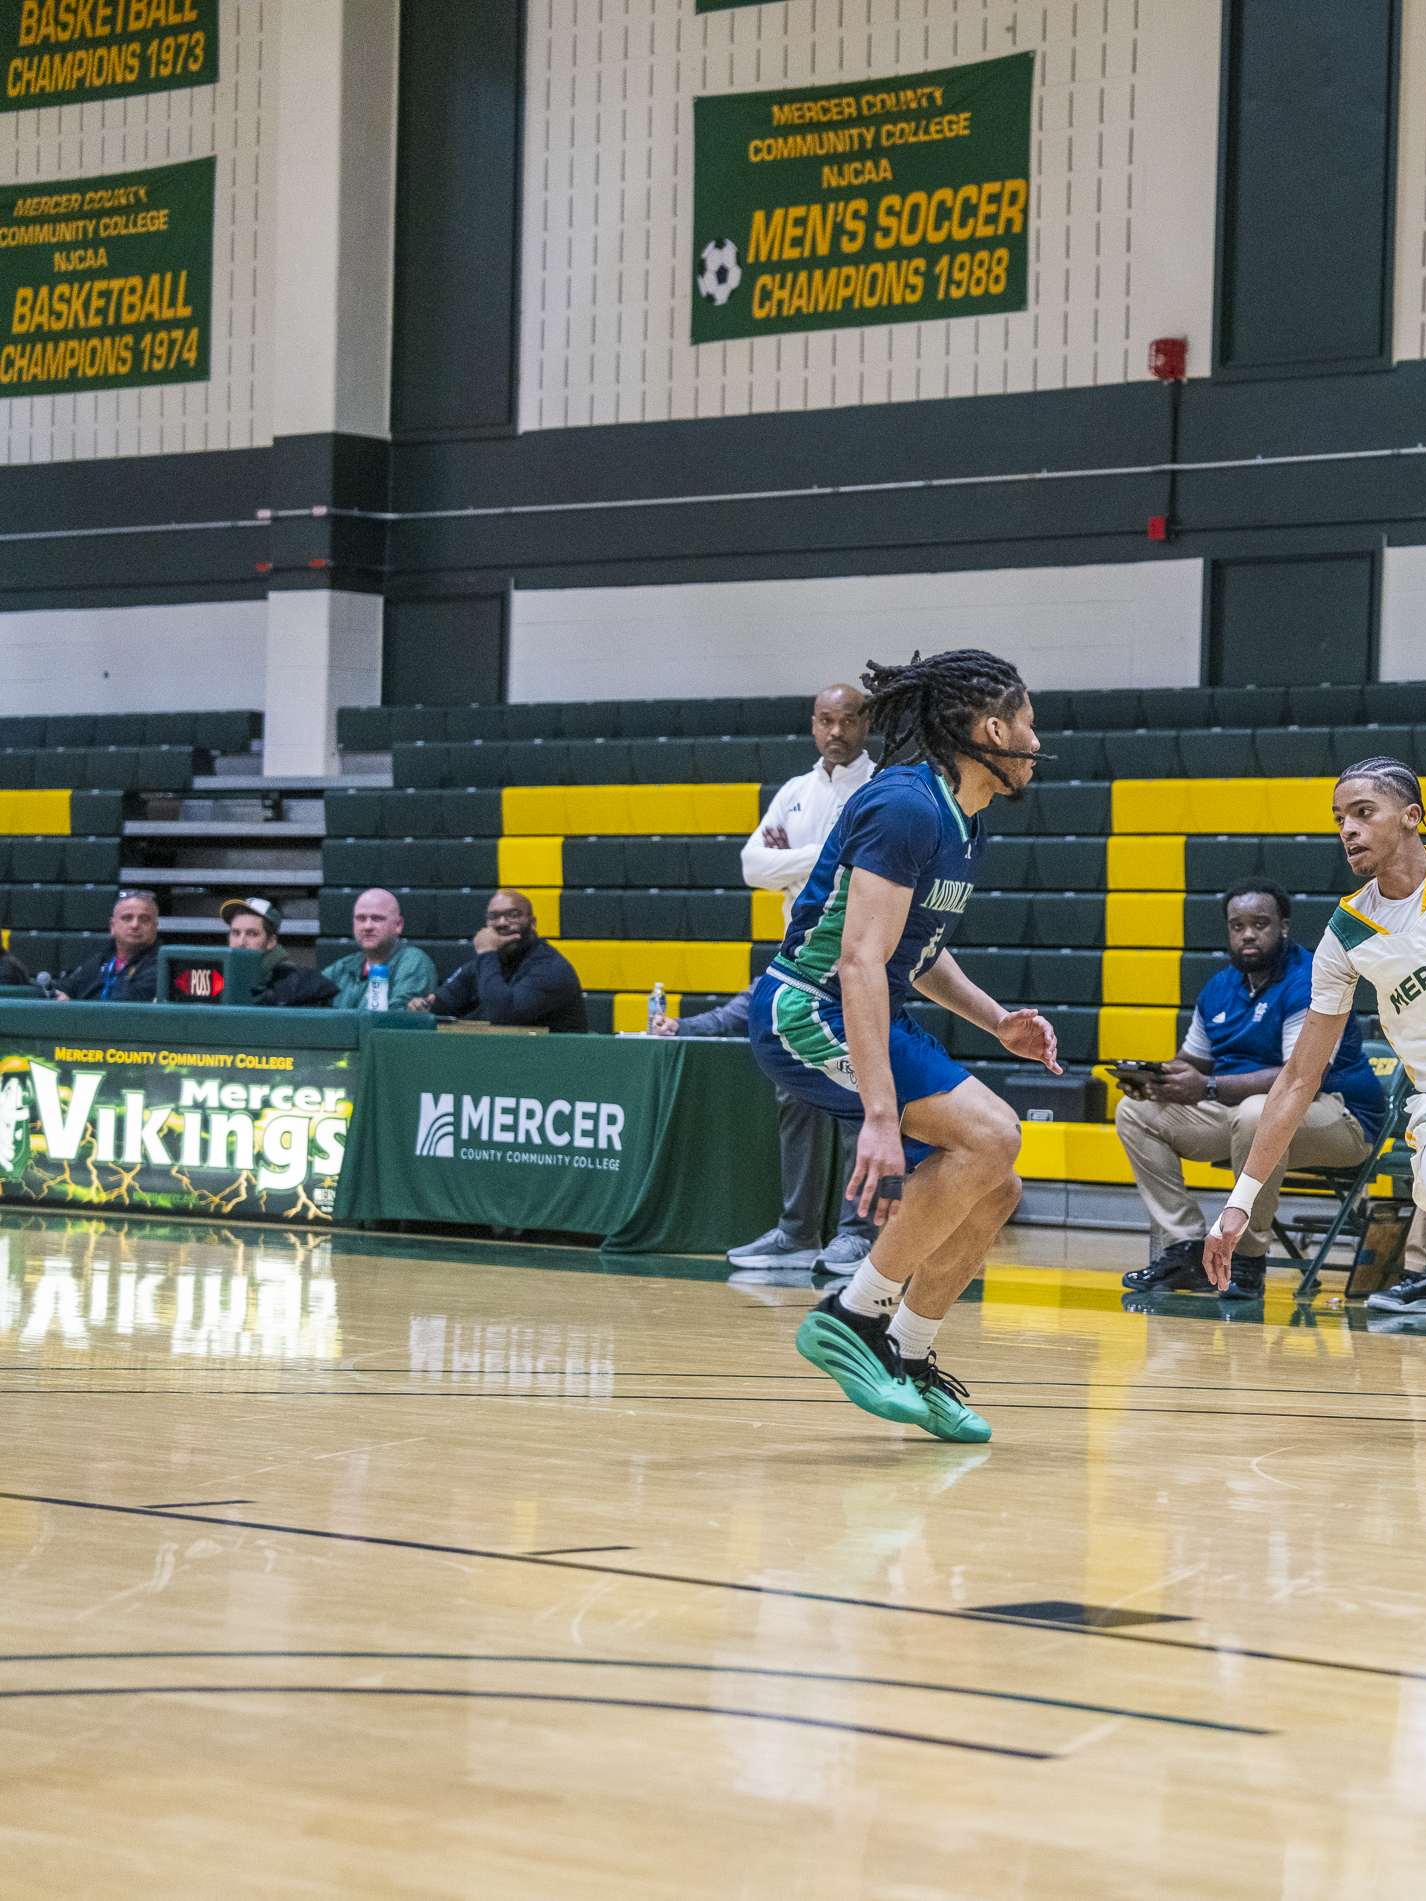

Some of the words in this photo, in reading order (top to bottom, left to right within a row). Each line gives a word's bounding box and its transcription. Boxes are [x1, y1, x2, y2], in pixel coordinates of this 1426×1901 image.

[7, 42, 141, 97] CHAMPIONS
[147, 31, 204, 78] 1973
[772, 97, 857, 126] MERCER
[861, 86, 944, 116] COUNTY
[749, 126, 876, 162] COMMUNITY
[880, 112, 972, 147] COLLEGE
[822, 158, 893, 188] NJCAA
[13, 193, 82, 217] MERCER
[83, 186, 147, 211] COUNTY
[747, 199, 868, 263] MEN'S
[874, 178, 1027, 249] SOCCER
[0, 219, 96, 247] COMMUNITY
[100, 209, 169, 238] COLLEGE
[54, 247, 108, 272] NJCAA
[12, 270, 192, 334] BASKETBALL
[752, 258, 926, 319] CHAMPIONS
[934, 248, 1009, 300] 1988
[0, 334, 134, 384] CHAMPIONS
[140, 327, 199, 372] 1974
[920, 878, 974, 914] MIDDLE
[190, 969, 210, 996] POSS
[55, 1047, 103, 1062] MERCER
[106, 1049, 156, 1064] COUNTY
[159, 1051, 233, 1067] COMMUNITY
[236, 1054, 293, 1070] COLLEGE
[181, 1079, 345, 1111] Mercer
[29, 1060, 347, 1190] Vikings
[461, 1095, 625, 1150] MERCER
[460, 1148, 502, 1161] COUNTY
[506, 1151, 571, 1166] COMMUNITY
[573, 1155, 621, 1171] COLLEGE
